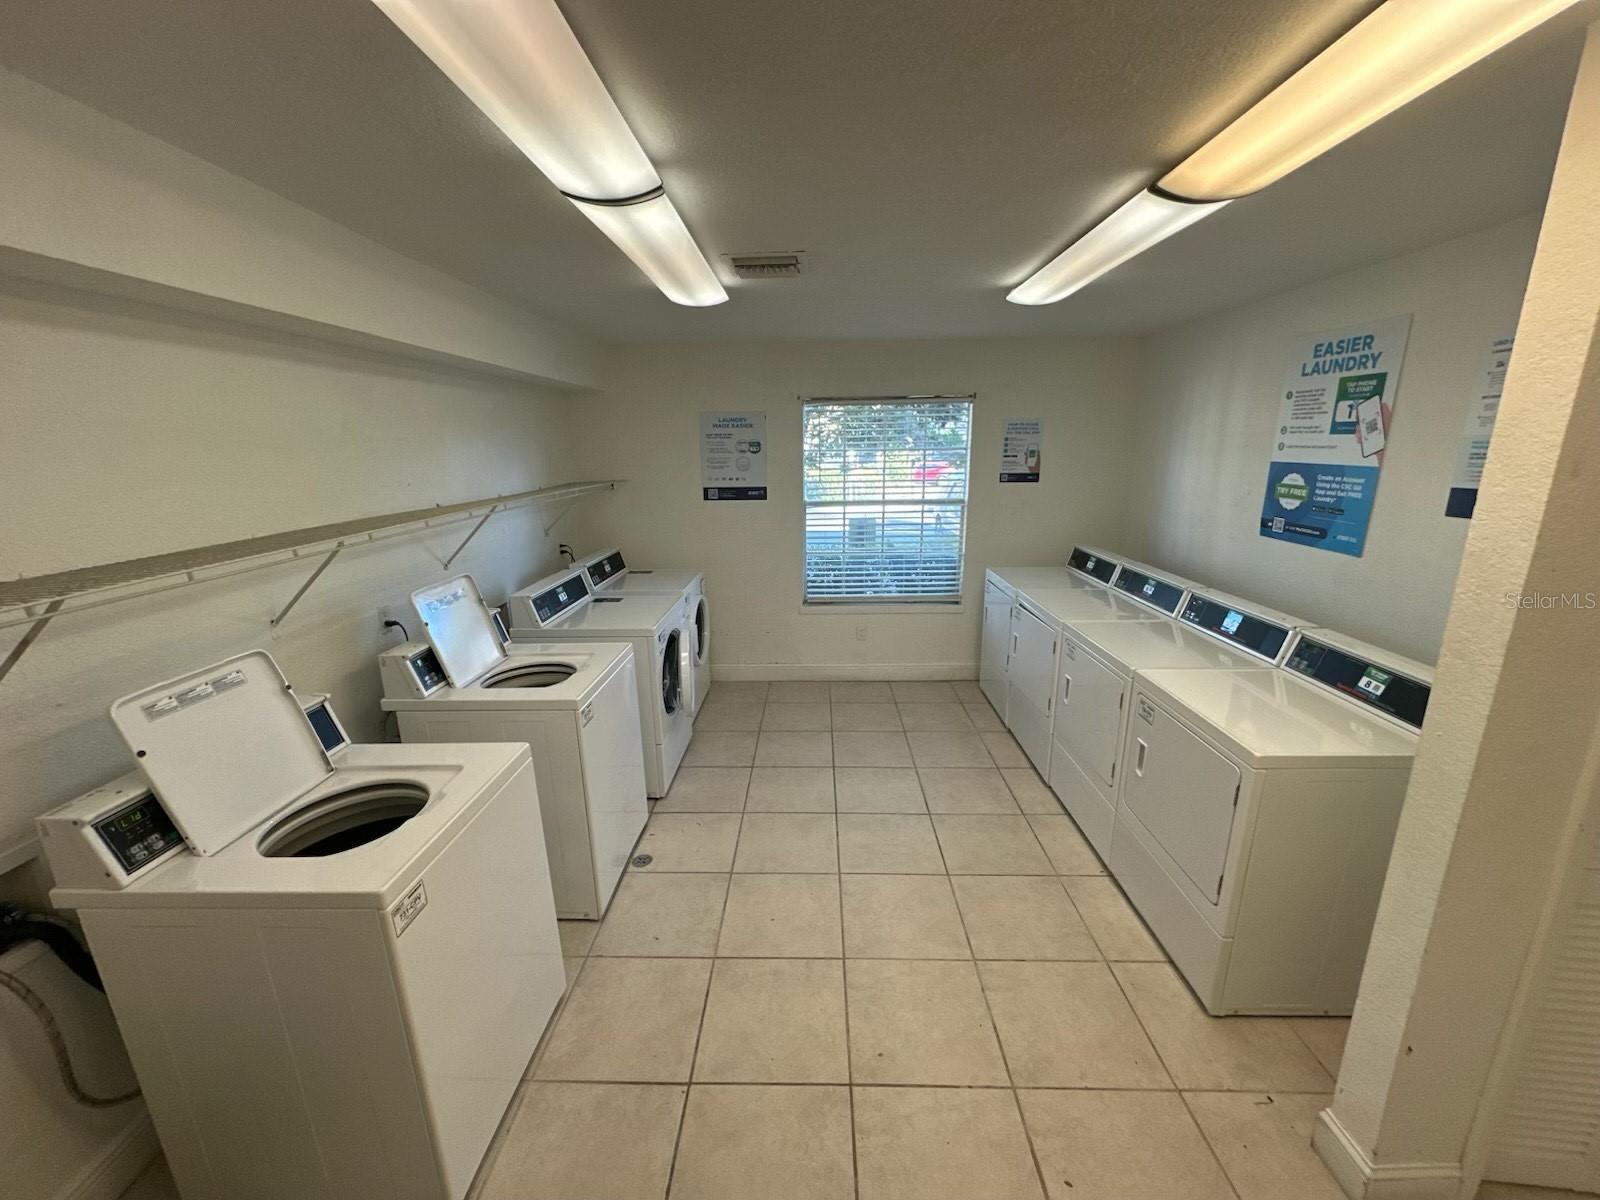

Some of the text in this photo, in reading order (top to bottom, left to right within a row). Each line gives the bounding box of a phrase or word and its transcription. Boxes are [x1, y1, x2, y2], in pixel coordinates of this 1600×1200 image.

[1312, 334, 1375, 359] EASIER
[1301, 352, 1383, 377] LAUNDRY
[1277, 486, 1307, 497] TRY FREE
